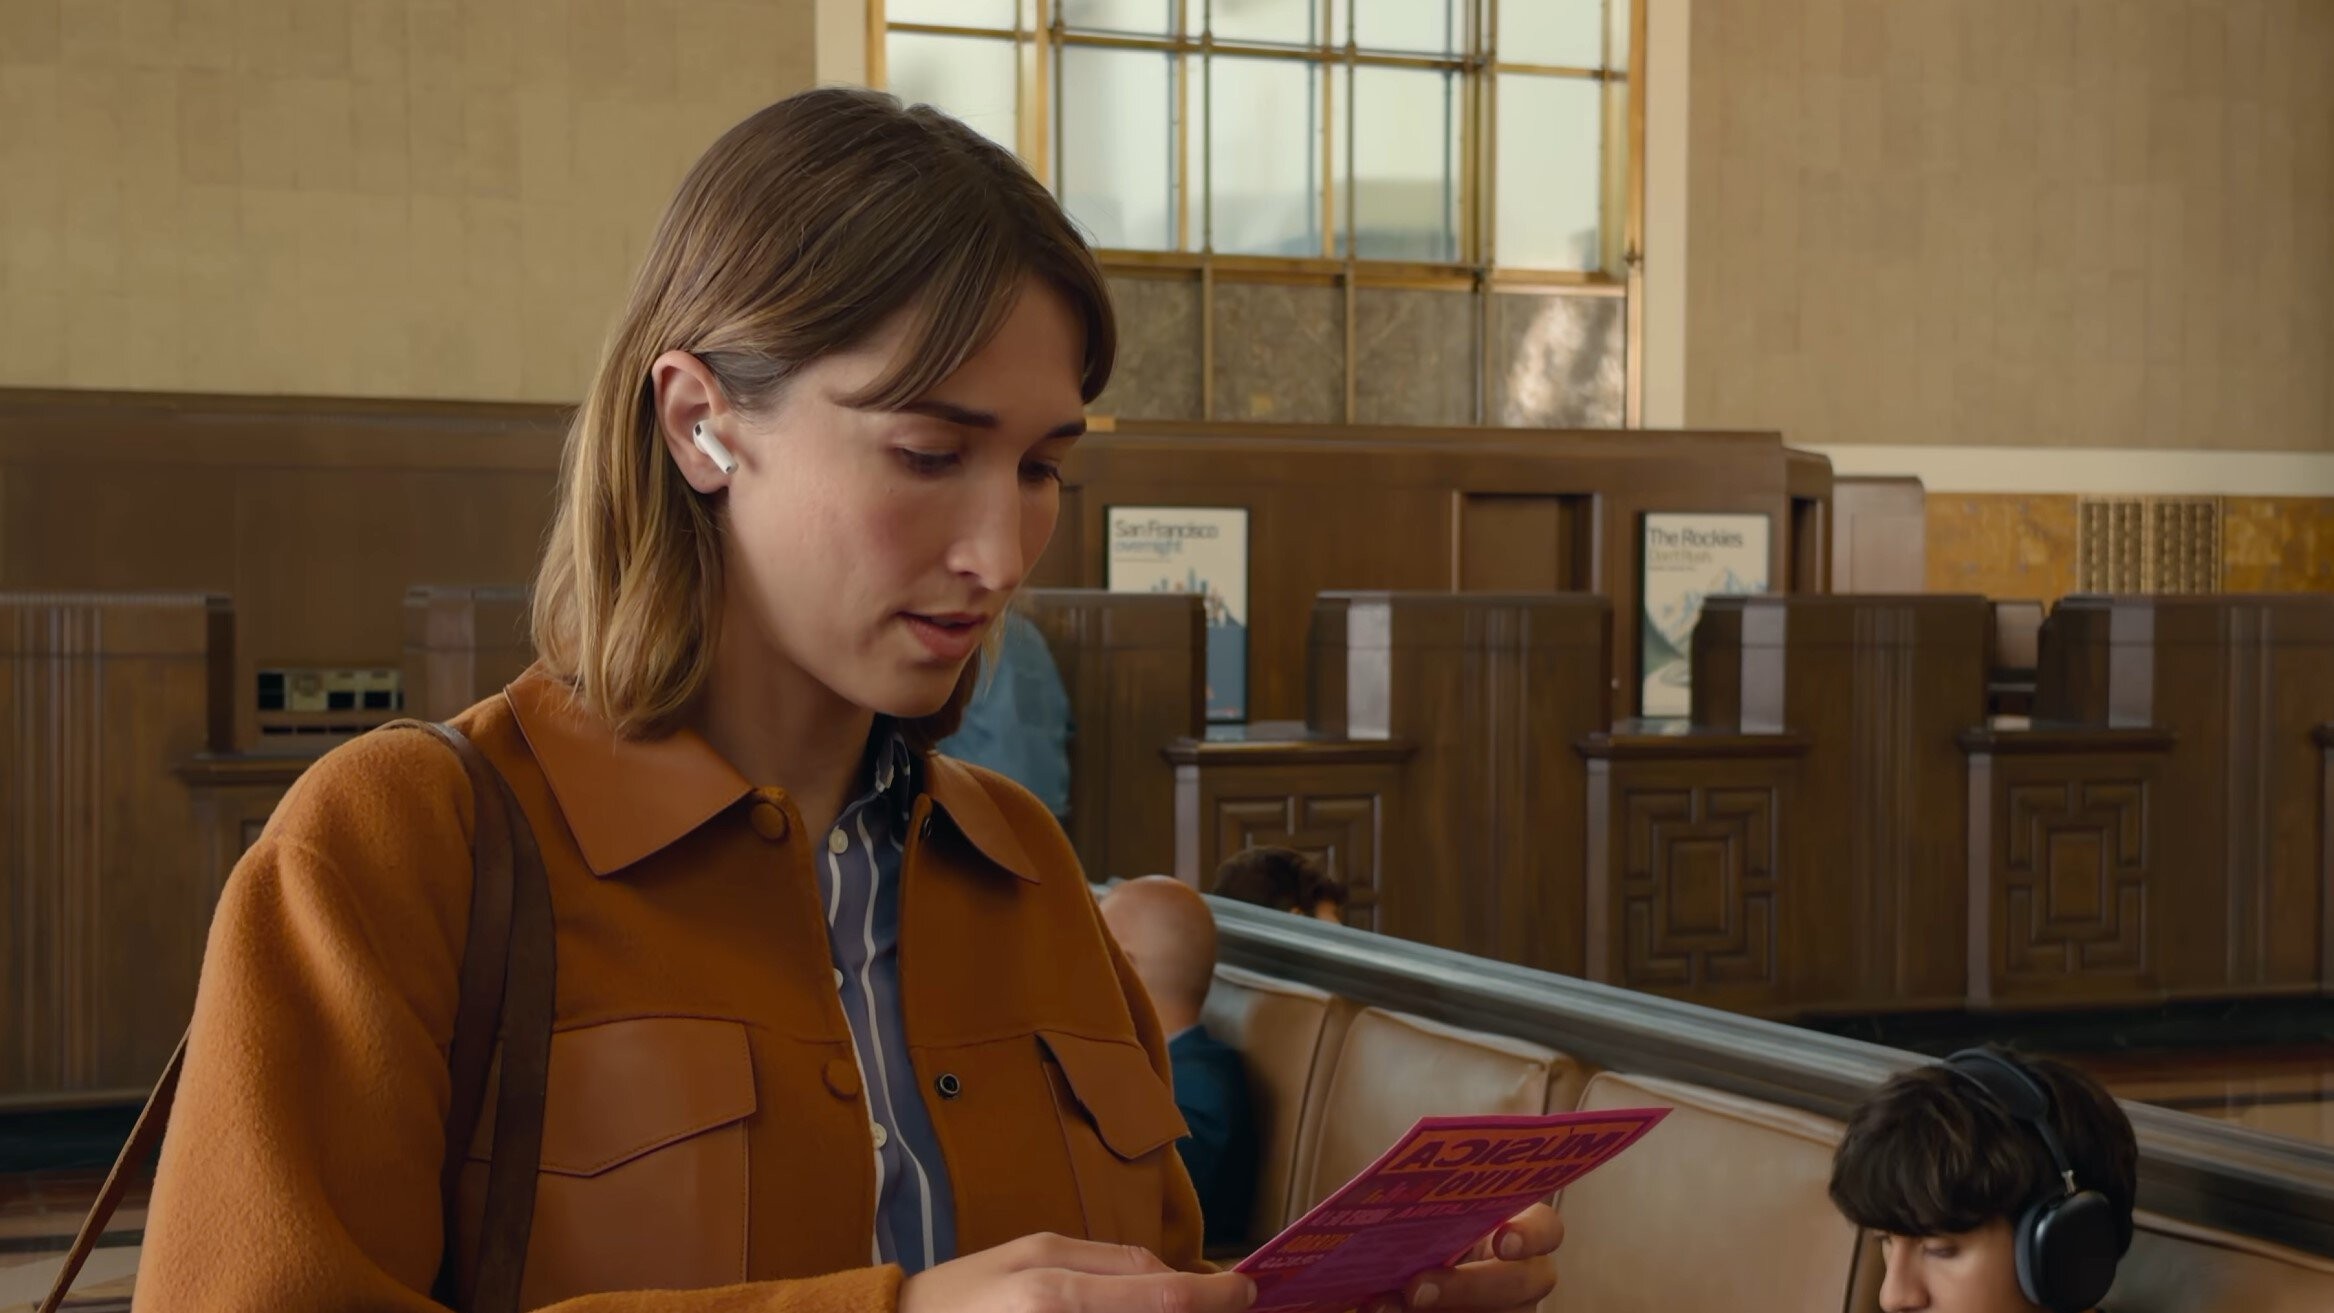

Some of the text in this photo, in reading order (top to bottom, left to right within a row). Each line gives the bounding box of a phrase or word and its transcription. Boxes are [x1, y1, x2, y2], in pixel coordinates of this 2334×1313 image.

[1115, 519, 1219, 539] San Francisco
[1648, 527, 1744, 548] The Rockies
[1115, 540, 1183, 555] overnight
